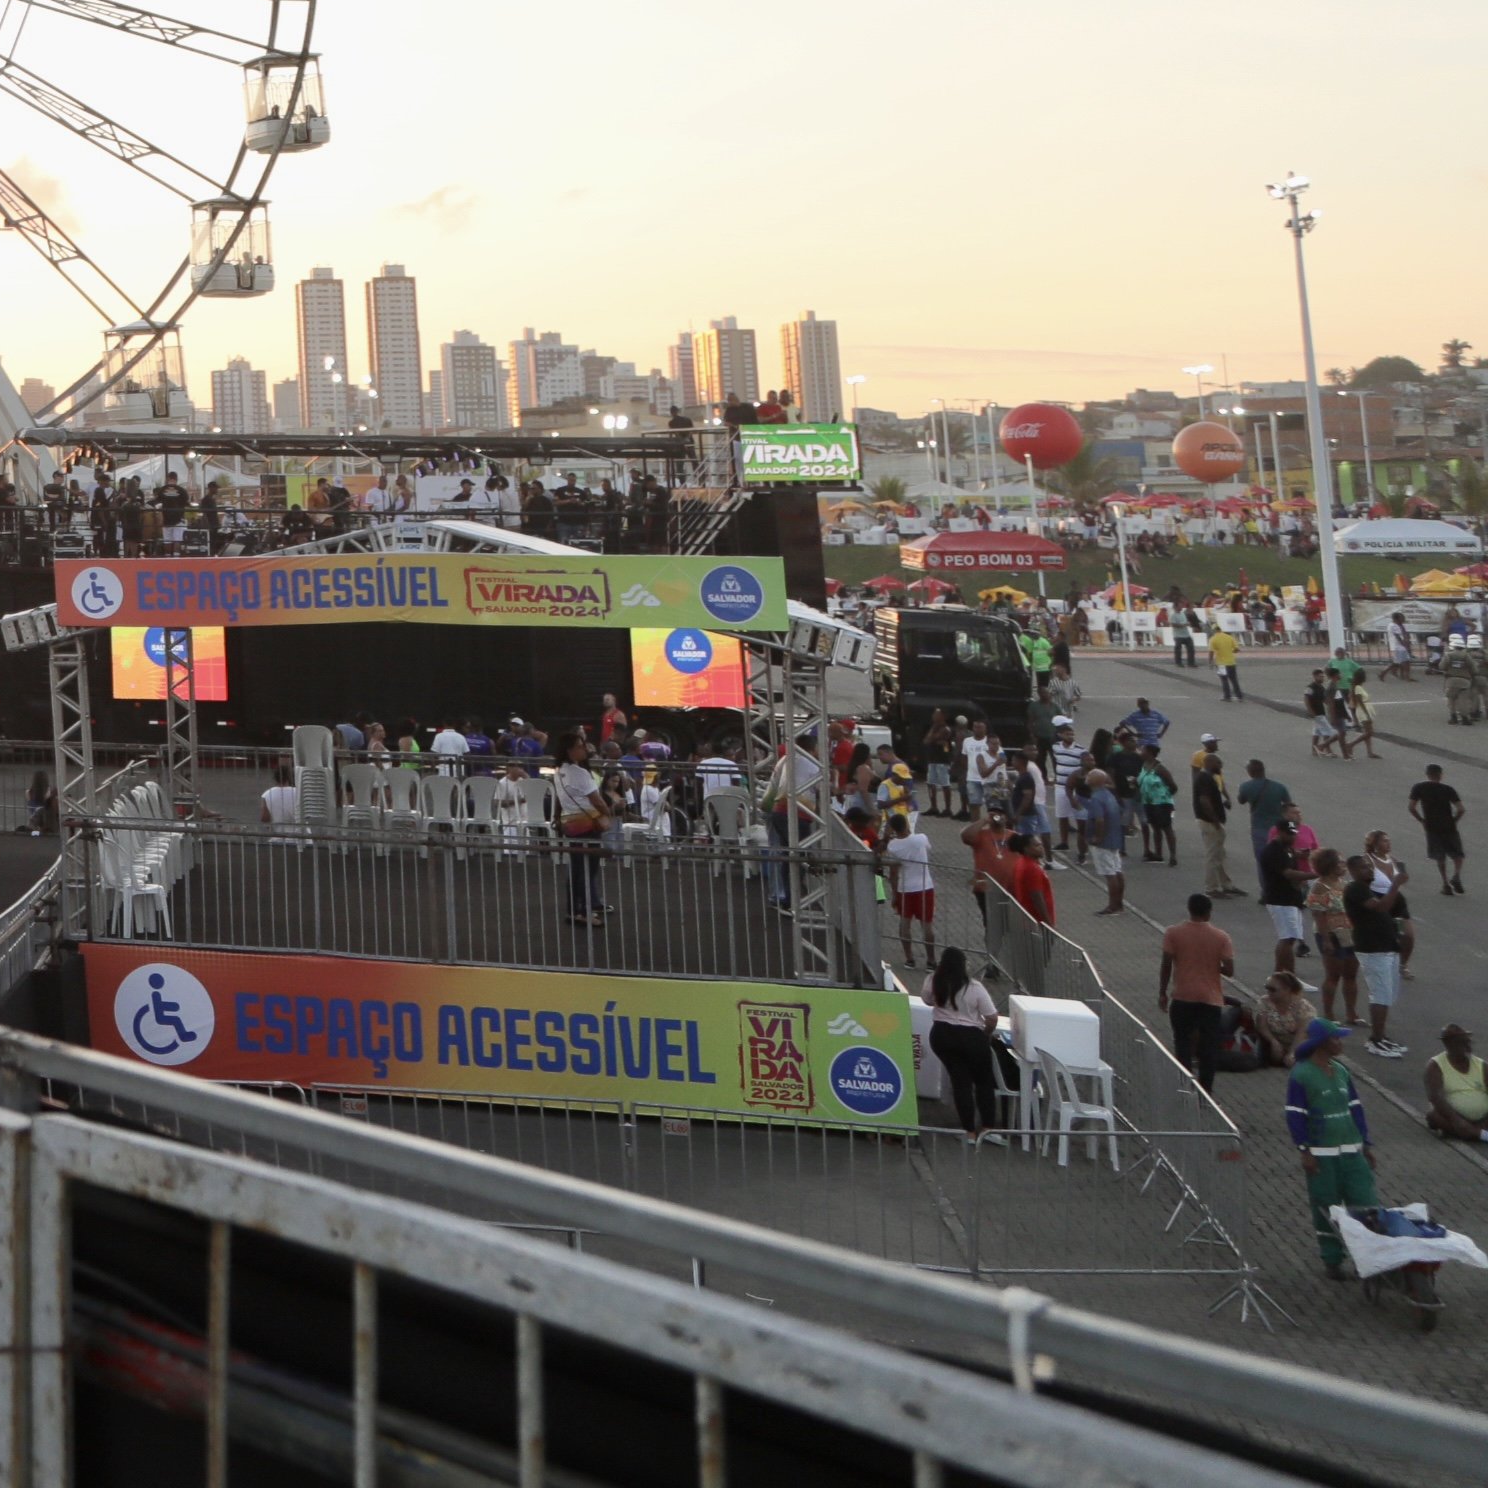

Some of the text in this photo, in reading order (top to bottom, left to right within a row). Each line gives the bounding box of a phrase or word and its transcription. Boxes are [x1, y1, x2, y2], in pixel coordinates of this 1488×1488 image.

[799, 465, 849, 476] 2024
[1406, 540, 1445, 548] MILITAR
[979, 554, 1012, 565] BOM
[1016, 555, 1033, 565] 03
[475, 576, 518, 584] FESTIVAL
[136, 557, 448, 622] ESPAÇO ACESSÍVEL
[476, 583, 600, 603] VIRADA
[707, 594, 756, 604] SALVADOR
[485, 605, 601, 617] SALVADOR 2024
[672, 650, 707, 658] SALVADOR
[746, 1009, 797, 1019] FESTIVAL
[748, 1016, 792, 1040] VI
[235, 992, 716, 1084] ESPAÇO ACESSÍVEL
[748, 1037, 804, 1062] RA
[751, 1059, 804, 1083] DA
[751, 1080, 805, 1091] SALVADOR
[838, 1078, 894, 1094] SALVADOR
[751, 1088, 805, 1102] 2024
